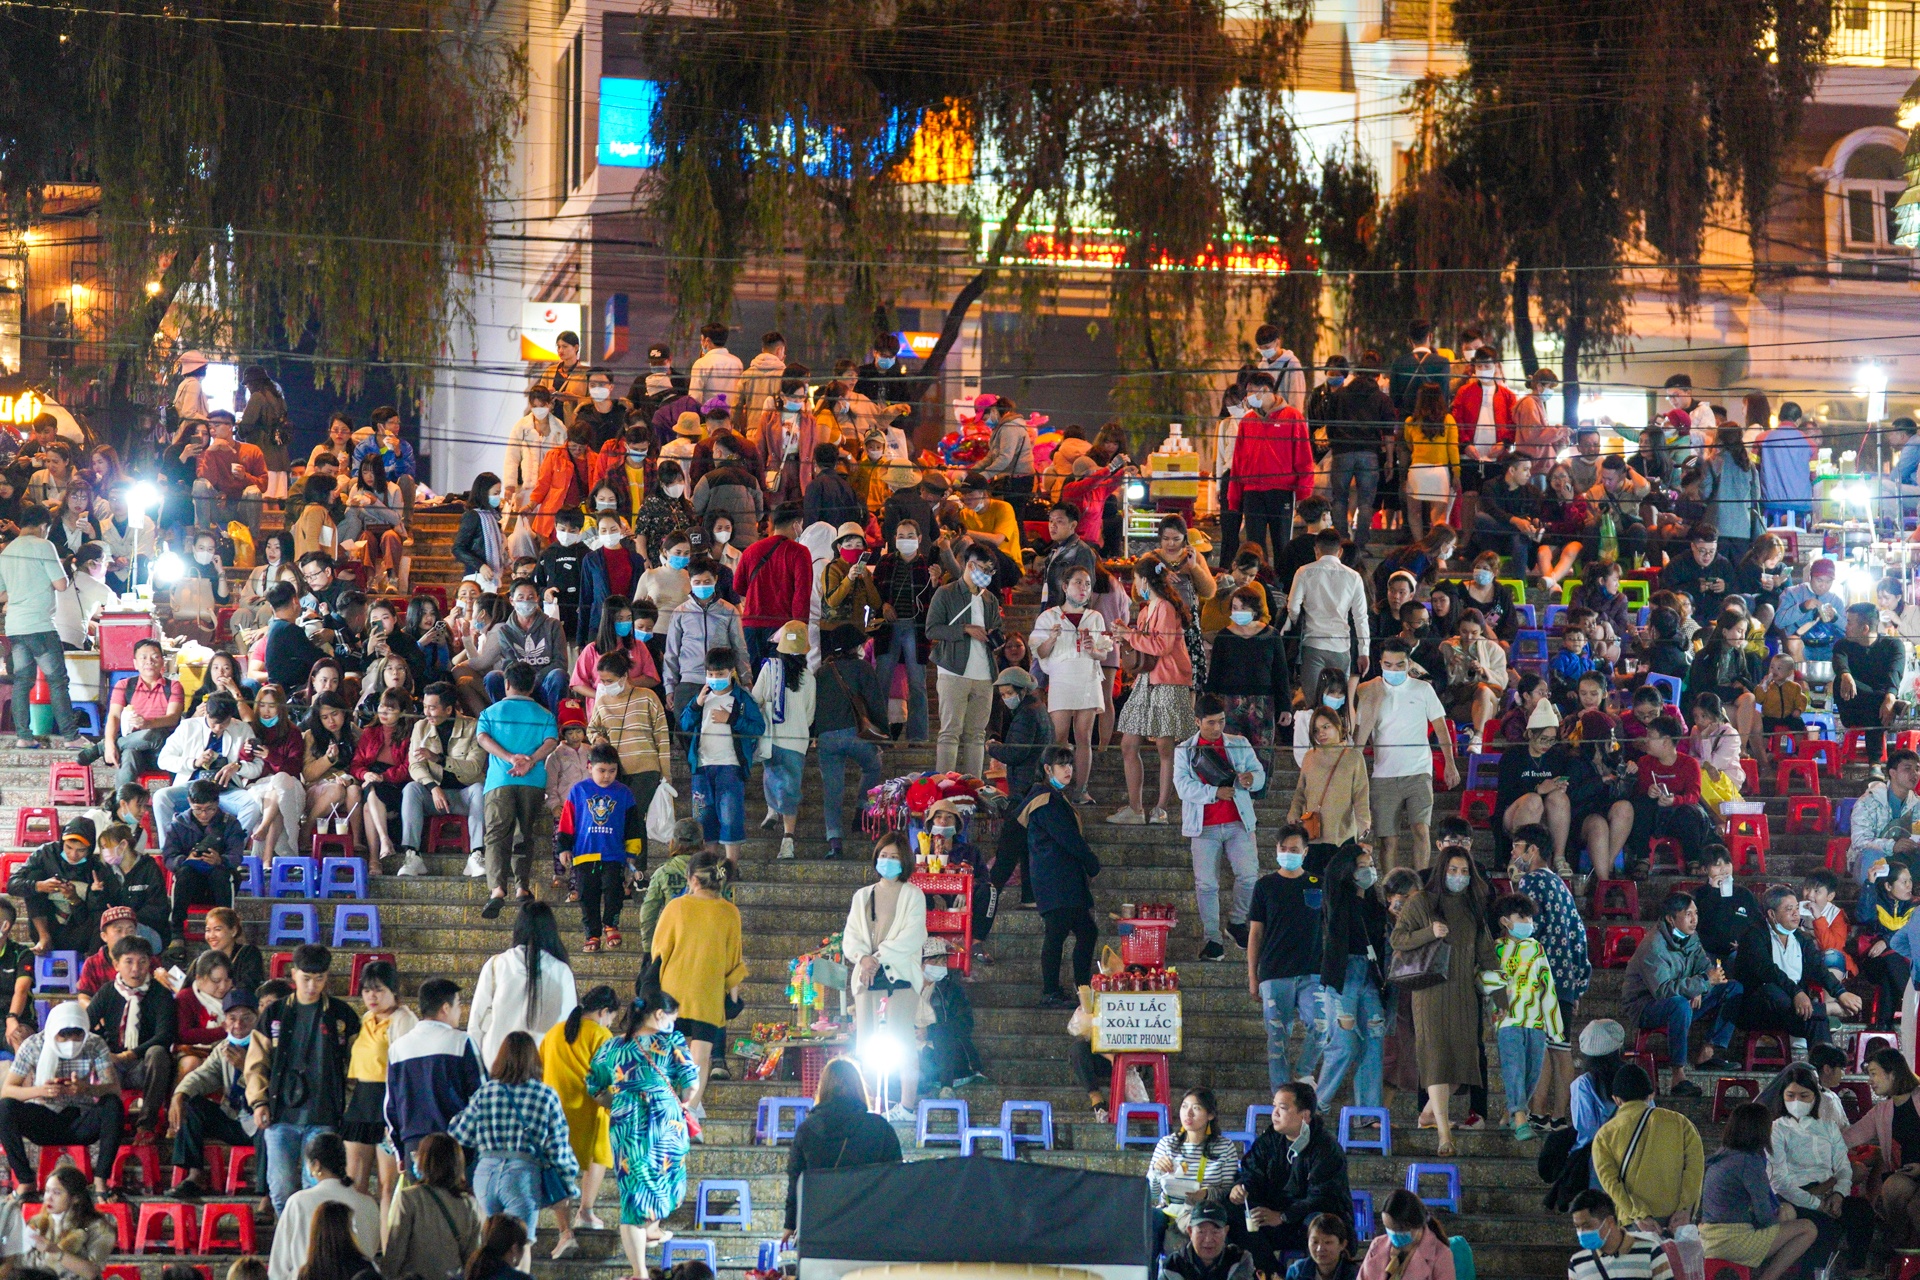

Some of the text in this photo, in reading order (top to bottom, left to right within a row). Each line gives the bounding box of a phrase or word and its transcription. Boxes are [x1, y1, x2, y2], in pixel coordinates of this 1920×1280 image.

[588, 826, 613, 834] VICTORY
[1107, 998, 1167, 1012] DÂU LẮC
[1106, 1015, 1172, 1028] XOÀI LẮC
[1106, 1034, 1171, 1045] YAOURT PHOMAI
